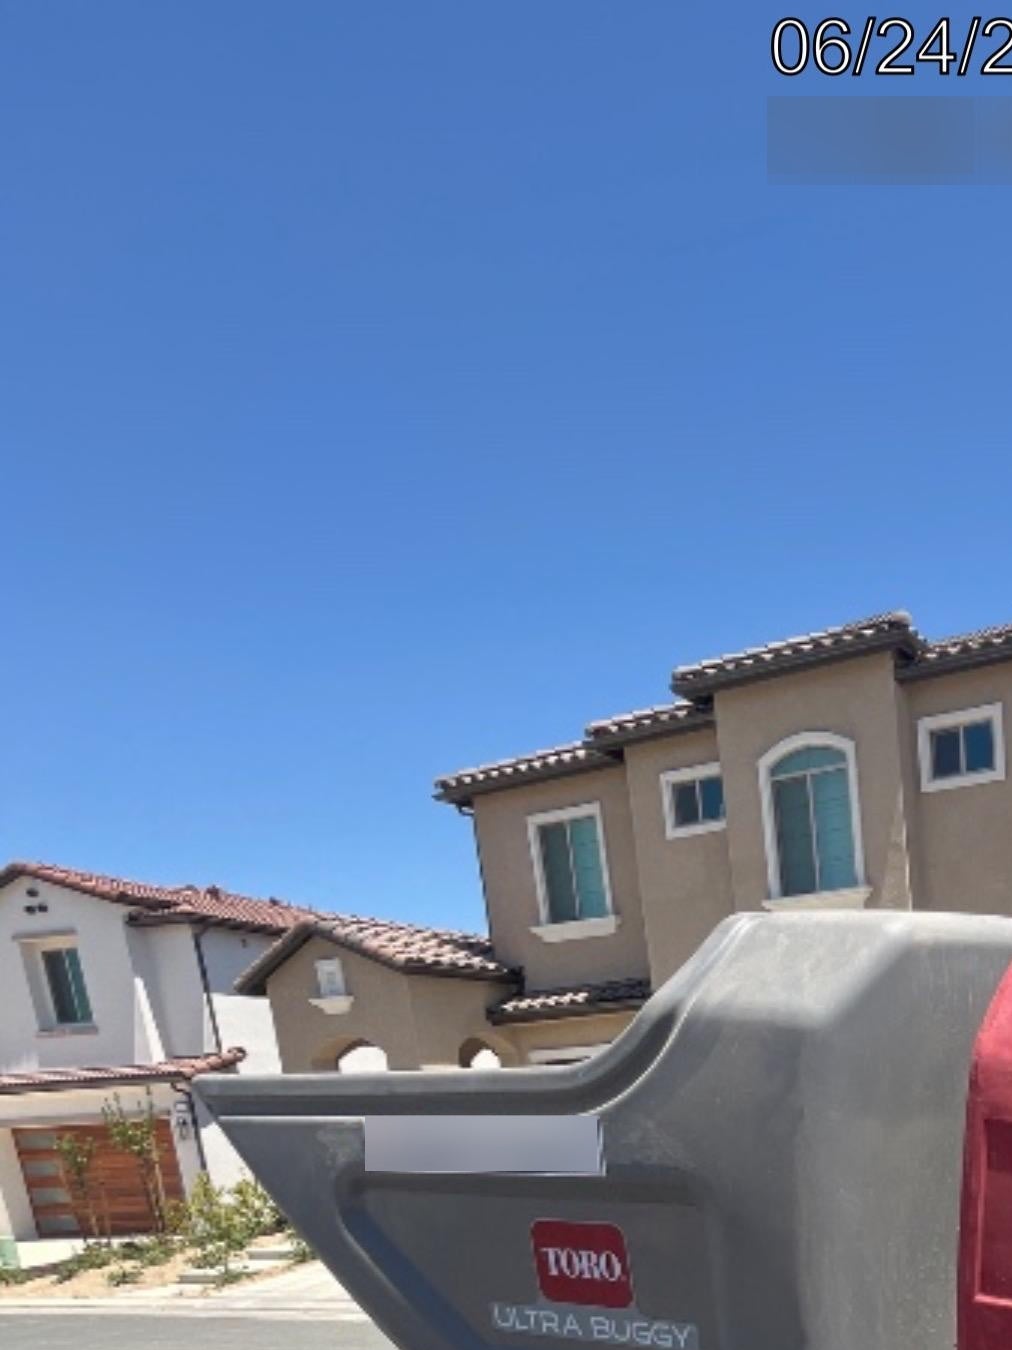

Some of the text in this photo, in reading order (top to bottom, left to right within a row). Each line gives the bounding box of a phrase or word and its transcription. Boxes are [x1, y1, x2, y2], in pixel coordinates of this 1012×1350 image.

[540, 1246, 622, 1282] TORO
[493, 1303, 692, 1349] ULTRA BUGGY
